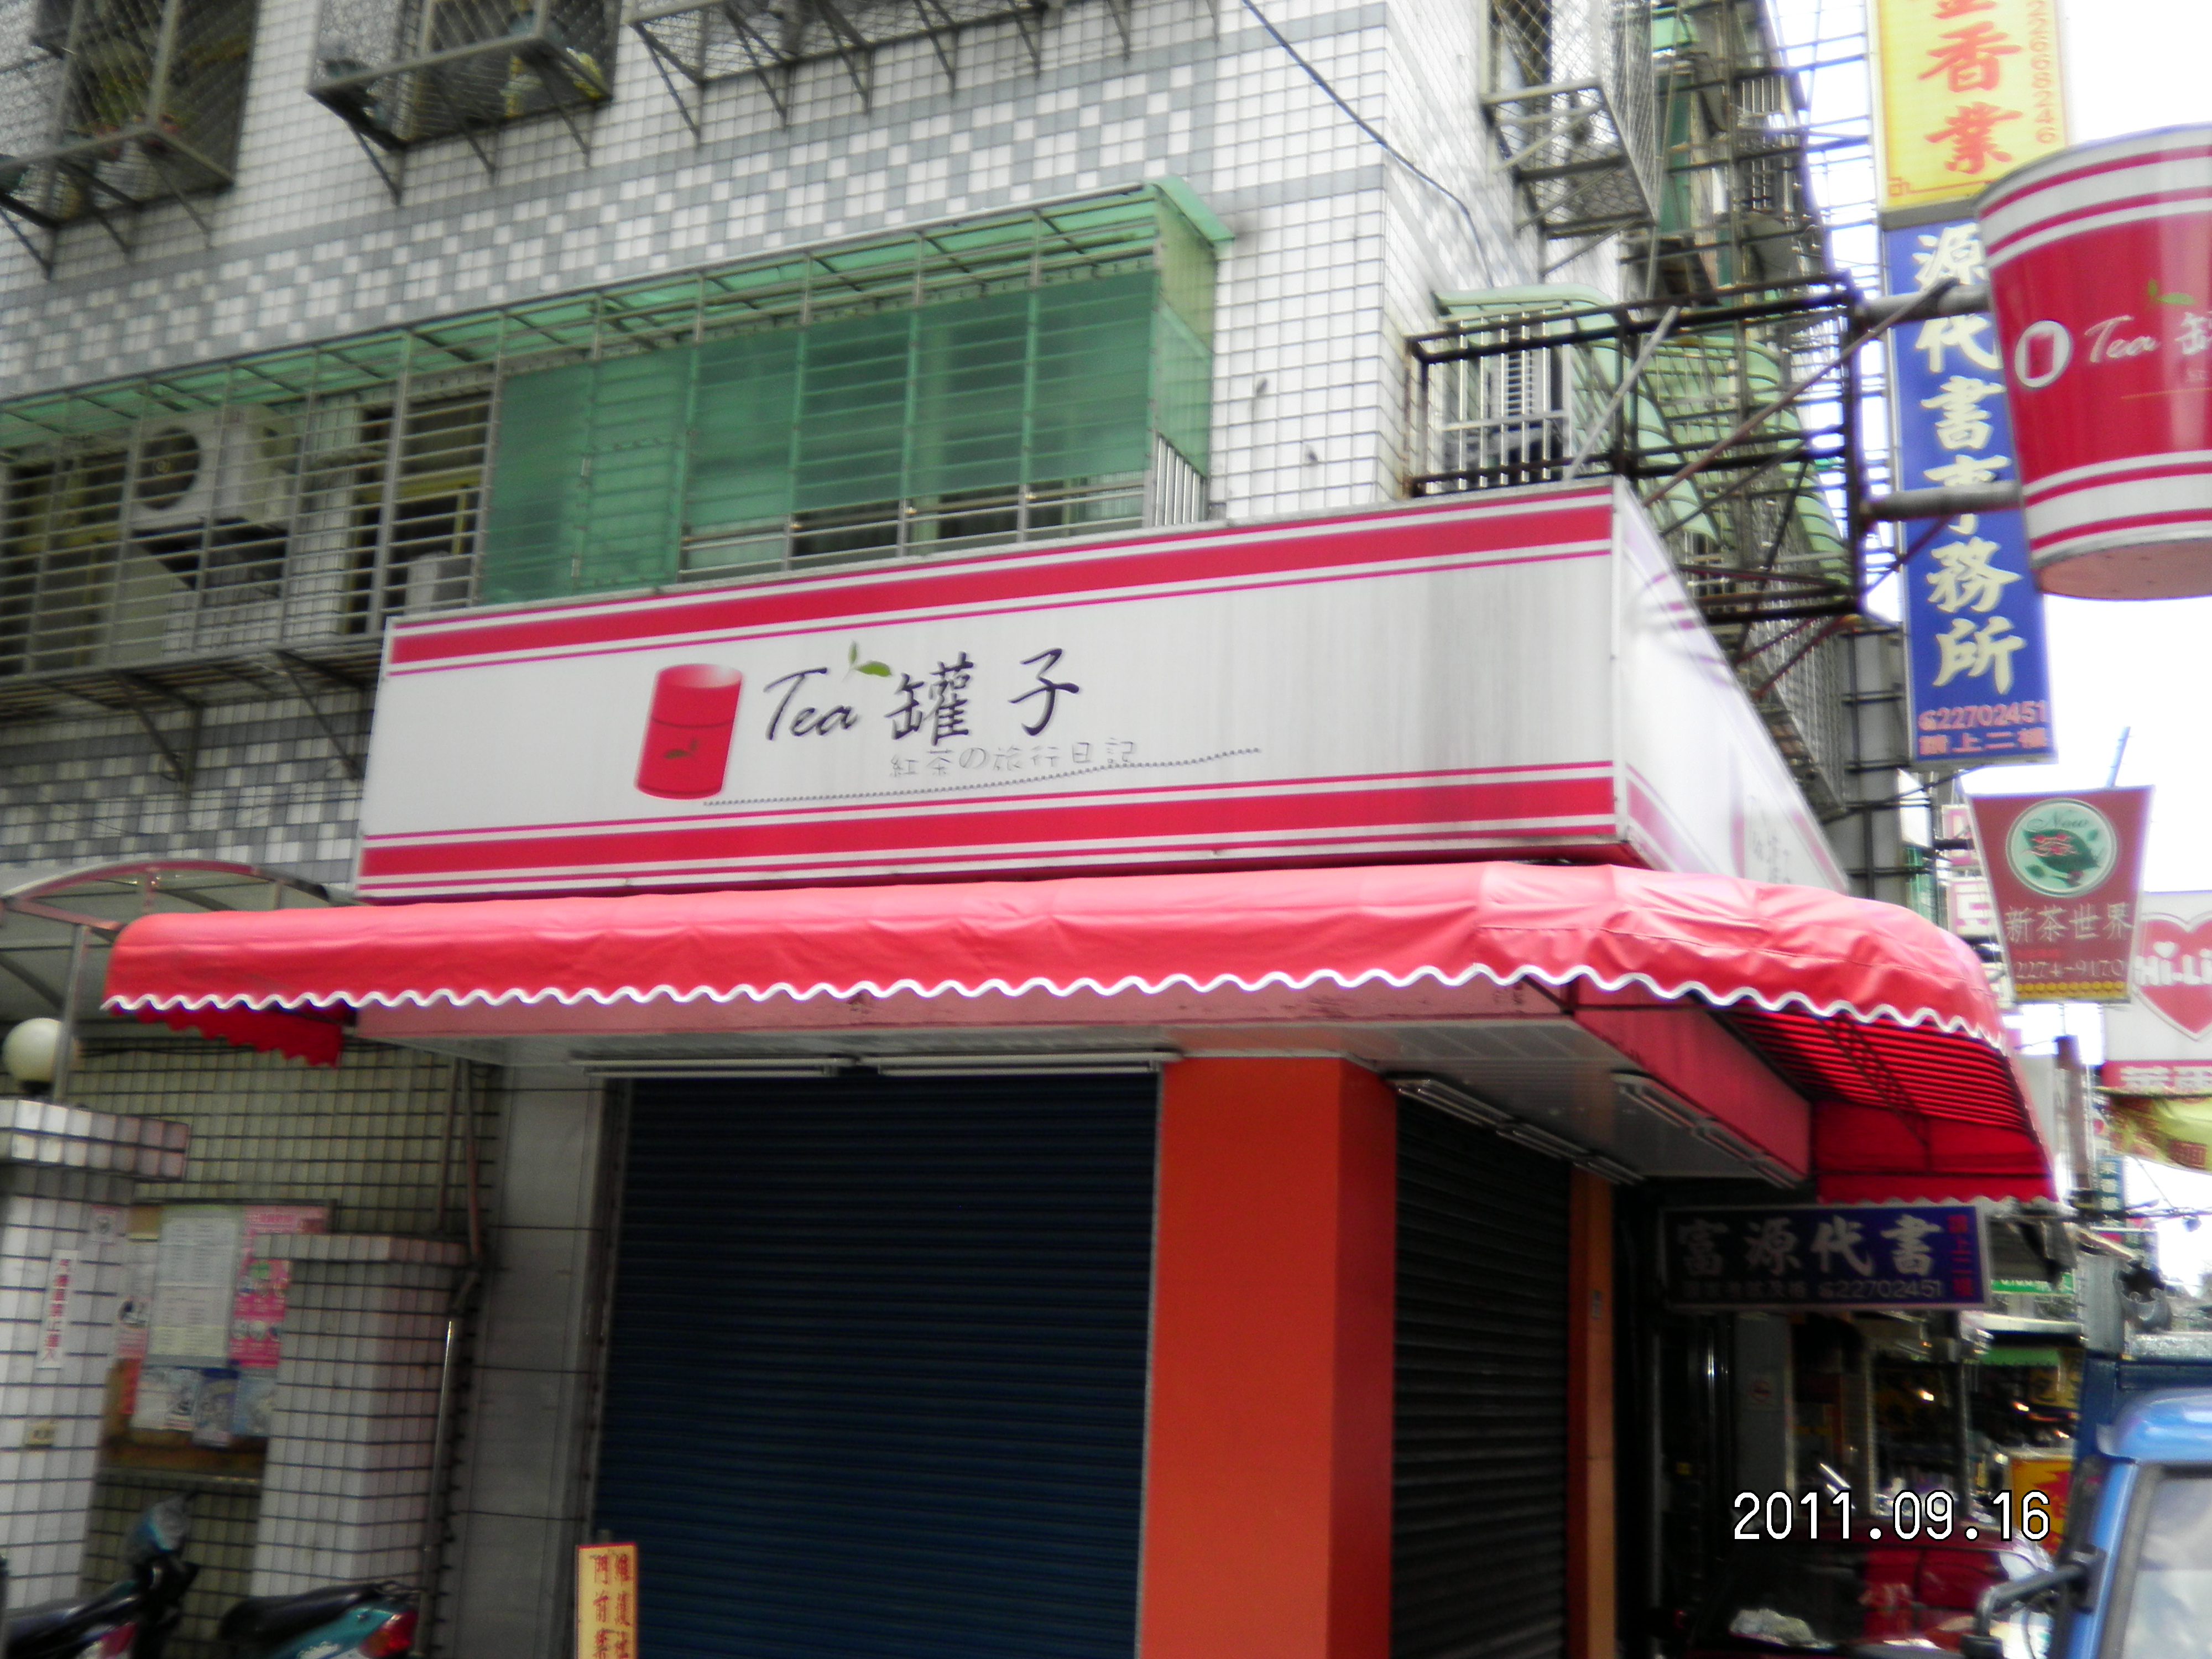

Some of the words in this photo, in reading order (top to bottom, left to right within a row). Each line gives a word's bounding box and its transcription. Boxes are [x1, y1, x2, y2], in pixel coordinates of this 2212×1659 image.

[2084, 315, 2160, 364] Tea
[763, 667, 858, 742] Tea
[885, 648, 1080, 745] 罐子
[1936, 700, 2046, 728] 22702451
[889, 739, 1138, 779] 紅茶の旅行日記
[2004, 902, 2133, 942] 新茶世界
[1678, 1213, 1943, 1275] 富源代書
[1838, 1279, 1944, 1299] 22702451
